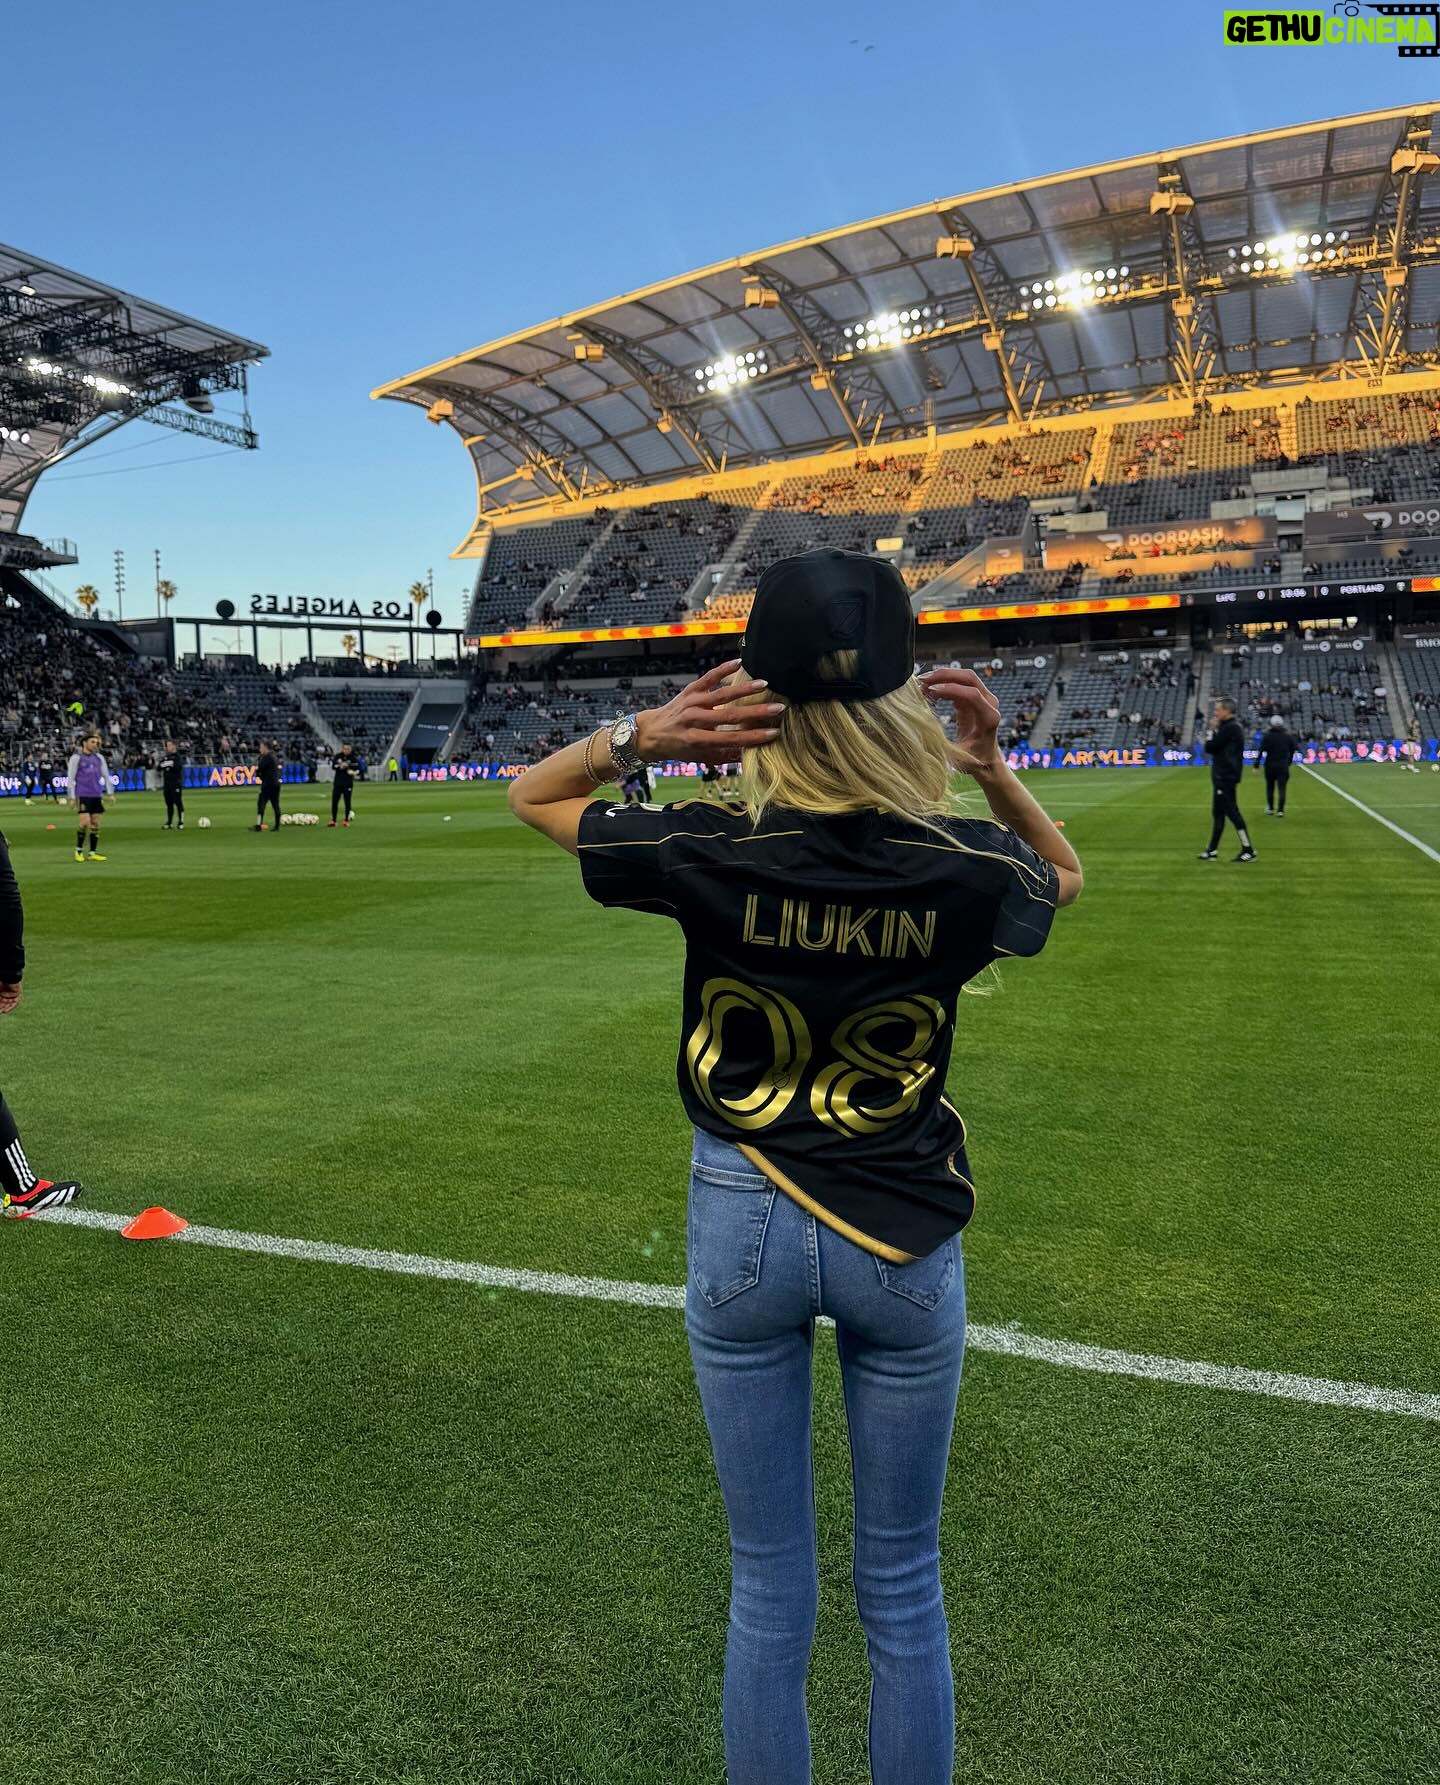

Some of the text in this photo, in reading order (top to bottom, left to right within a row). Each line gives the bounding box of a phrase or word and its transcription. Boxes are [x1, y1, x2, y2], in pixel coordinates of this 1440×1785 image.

[1128, 527, 1224, 546] DOORDASH
[1340, 584, 1385, 595] PORTLAND
[208, 766, 263, 786] ARGY
[742, 894, 937, 958] LIUKIN
[686, 977, 946, 1138] 08
